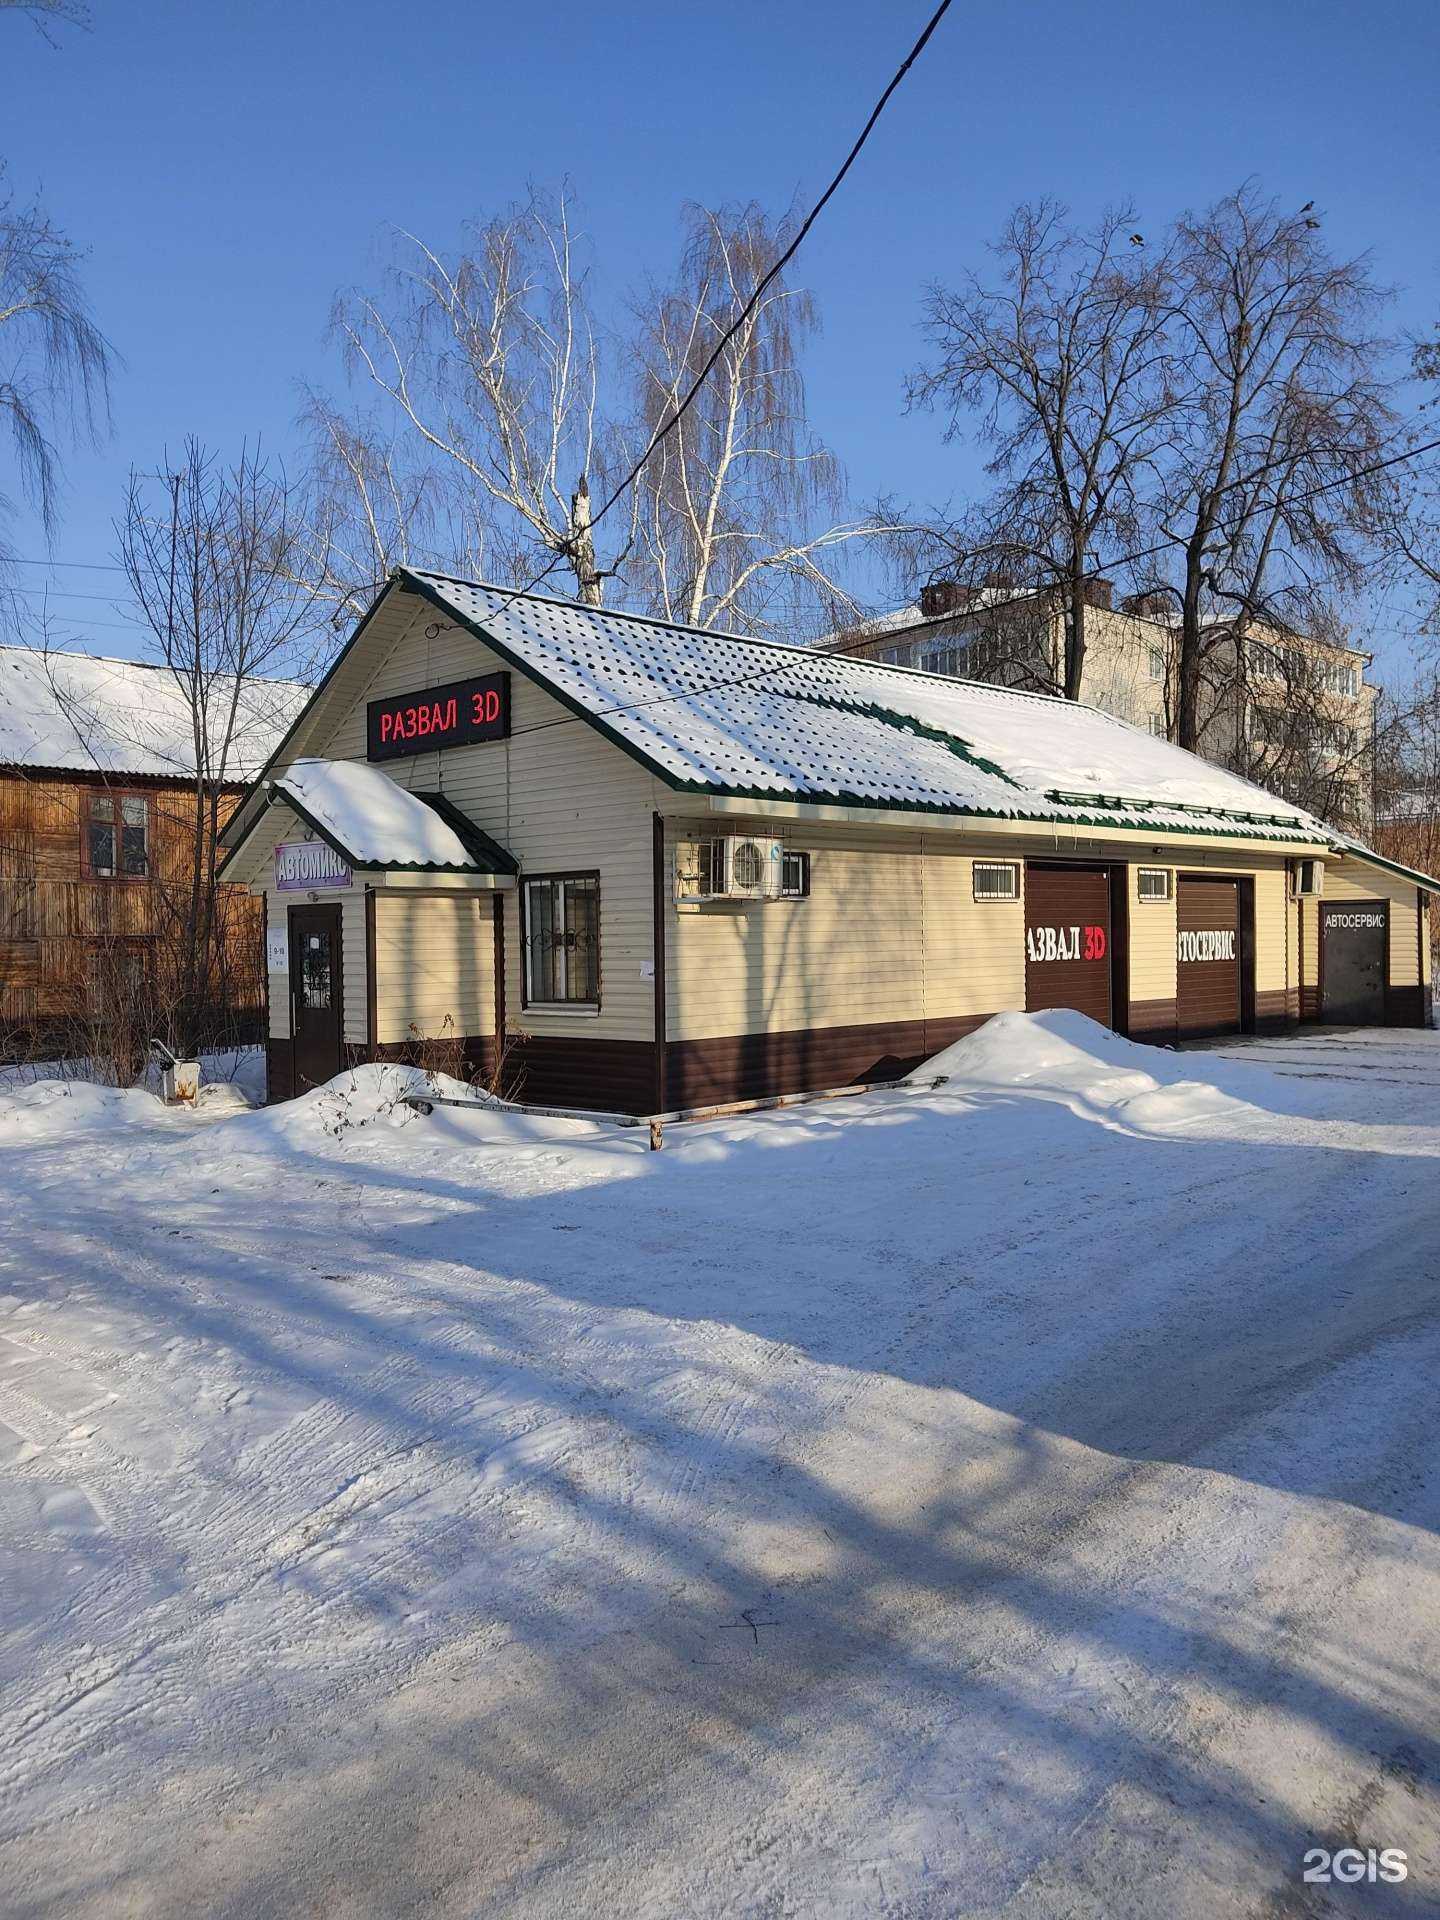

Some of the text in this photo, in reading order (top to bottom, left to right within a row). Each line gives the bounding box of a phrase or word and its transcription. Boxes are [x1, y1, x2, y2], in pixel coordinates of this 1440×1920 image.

[381, 690, 499, 742] РАЗВАЛ 3D
[1325, 914, 1385, 928] АВТОСЕРВИС
[1084, 926, 1106, 960] 3D
